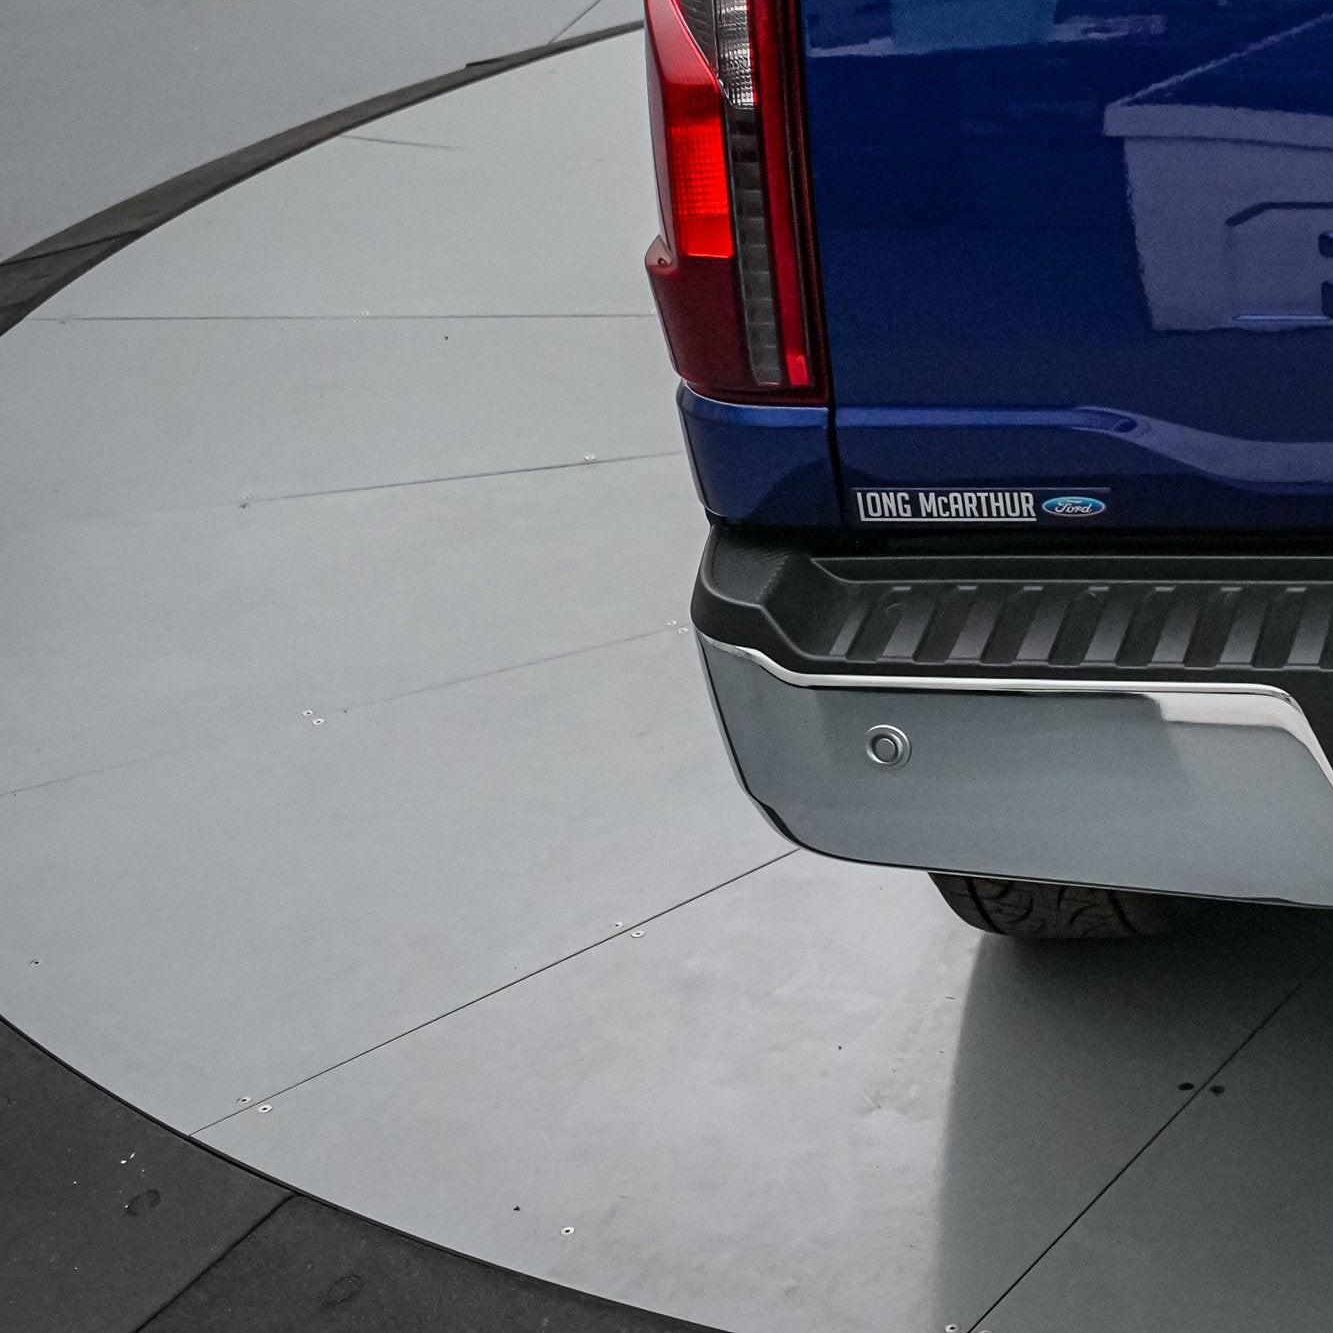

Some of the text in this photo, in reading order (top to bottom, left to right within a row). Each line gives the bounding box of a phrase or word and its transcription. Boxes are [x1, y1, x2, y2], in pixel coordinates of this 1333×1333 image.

[857, 491, 1094, 520] LONG McARTHUR Ford
